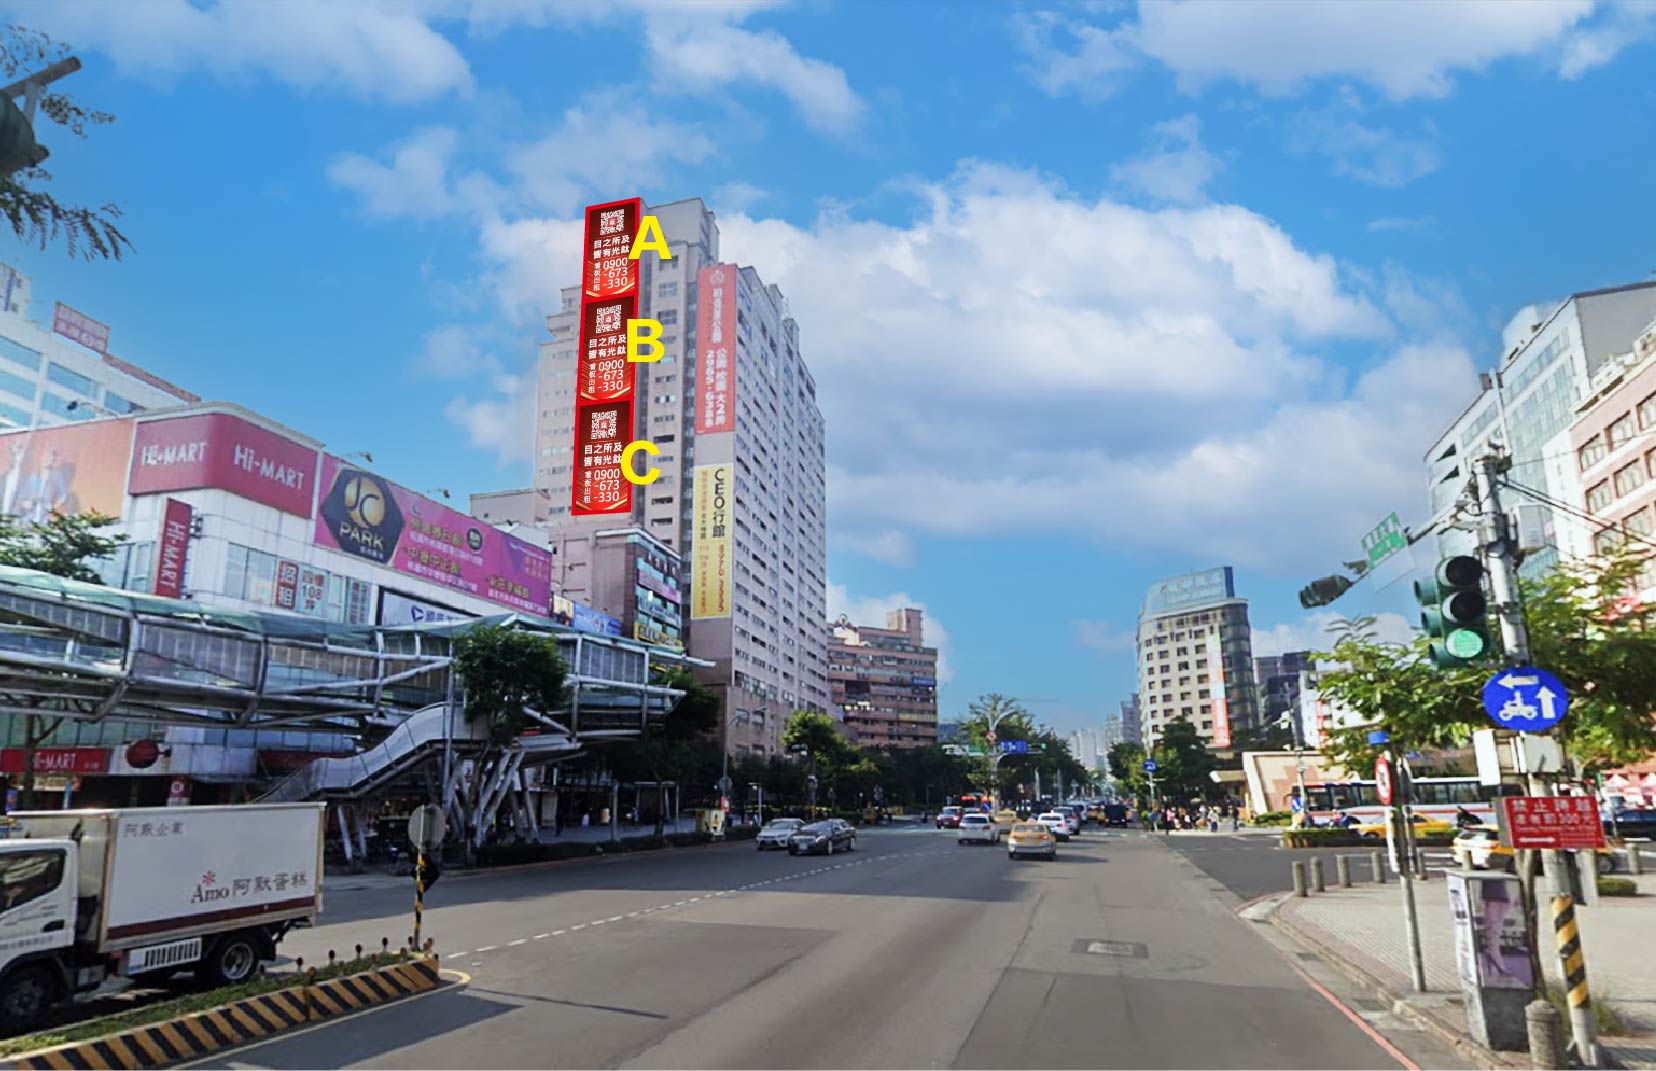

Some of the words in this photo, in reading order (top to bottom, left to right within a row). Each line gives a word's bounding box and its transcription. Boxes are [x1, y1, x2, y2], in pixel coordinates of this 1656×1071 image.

[593, 234, 630, 250] 目之所及
[603, 257, 628, 270] 0900
[604, 267, 628, 279] -673
[602, 276, 628, 289] -330
[589, 334, 627, 349] 目之所及
[598, 359, 625, 372] 0900
[598, 370, 624, 382] -673
[597, 380, 624, 392] -330
[584, 442, 623, 455] 目之所及
[233, 443, 305, 491] Hi-MART
[593, 468, 621, 481] 0900
[594, 479, 620, 491] -673
[593, 491, 620, 503] -330
[339, 521, 384, 550] PARK
[302, 584, 322, 601] 108
[190, 883, 230, 905] Amo
